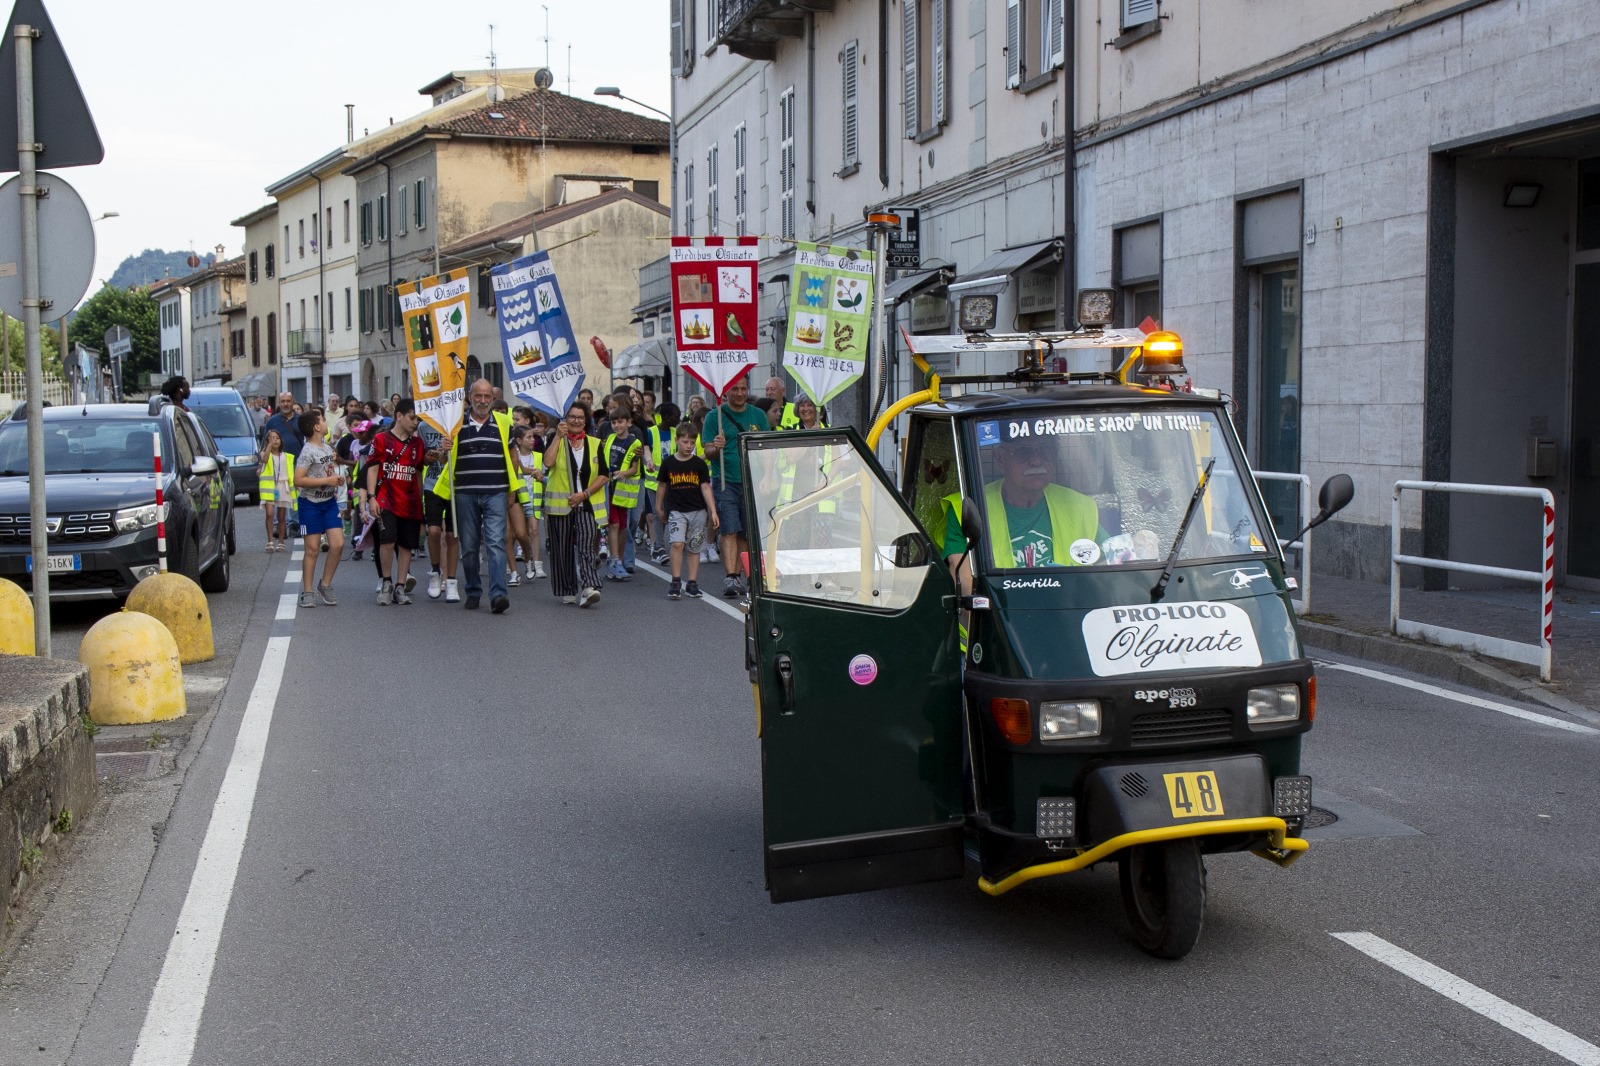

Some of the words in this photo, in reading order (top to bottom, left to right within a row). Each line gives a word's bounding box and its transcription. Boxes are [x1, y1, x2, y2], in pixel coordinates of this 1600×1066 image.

[674, 248, 711, 261] Piedibus
[893, 255, 920, 263] OTTO
[681, 351, 712, 364] SANTA
[716, 350, 748, 364] MARIA
[794, 353, 825, 368] LINEA
[828, 358, 854, 373] ALTA
[514, 371, 550, 392] LINEA
[1008, 420, 1030, 438] DA
[1034, 416, 1095, 437] GRANDE
[1142, 415, 1163, 431] UN
[1165, 414, 1202, 431] TIR!!!
[425, 432, 443, 440] STRE
[319, 455, 334, 465] SUPE
[669, 471, 700, 486] THRASHER
[47, 557, 73, 569] 616KV
[1003, 578, 1062, 590] Scintilla
[1112, 604, 1226, 624] PRO-LOCO
[1106, 623, 1243, 668] Olginate
[1168, 696, 1197, 708] P50
[1175, 774, 1217, 815] 48
